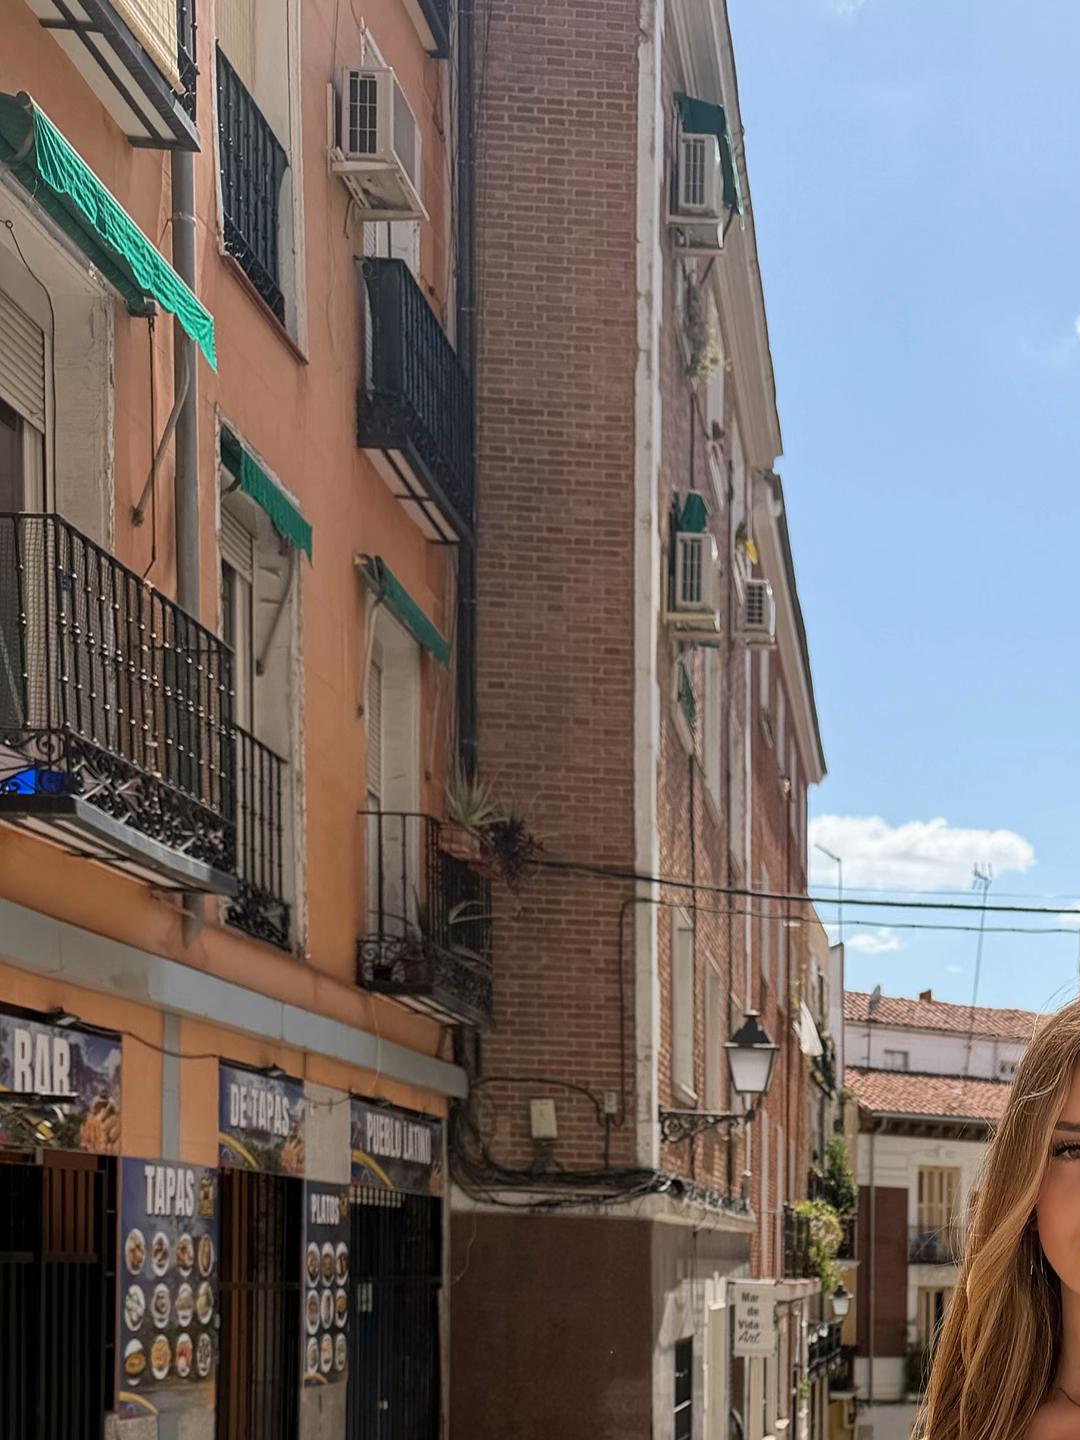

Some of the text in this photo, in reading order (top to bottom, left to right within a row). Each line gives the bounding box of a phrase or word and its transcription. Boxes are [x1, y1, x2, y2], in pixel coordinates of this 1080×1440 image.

[14, 1028, 71, 1096] BAR
[230, 1083, 290, 1137] DE TAPAS
[366, 1111, 432, 1165] PUEBLO LATINO
[144, 1164, 195, 1217] TAPAS
[310, 1193, 340, 1225] PLATOS
[741, 1292, 759, 1302] Mar
[747, 1306, 759, 1316] de
[738, 1319, 760, 1330] Vida
